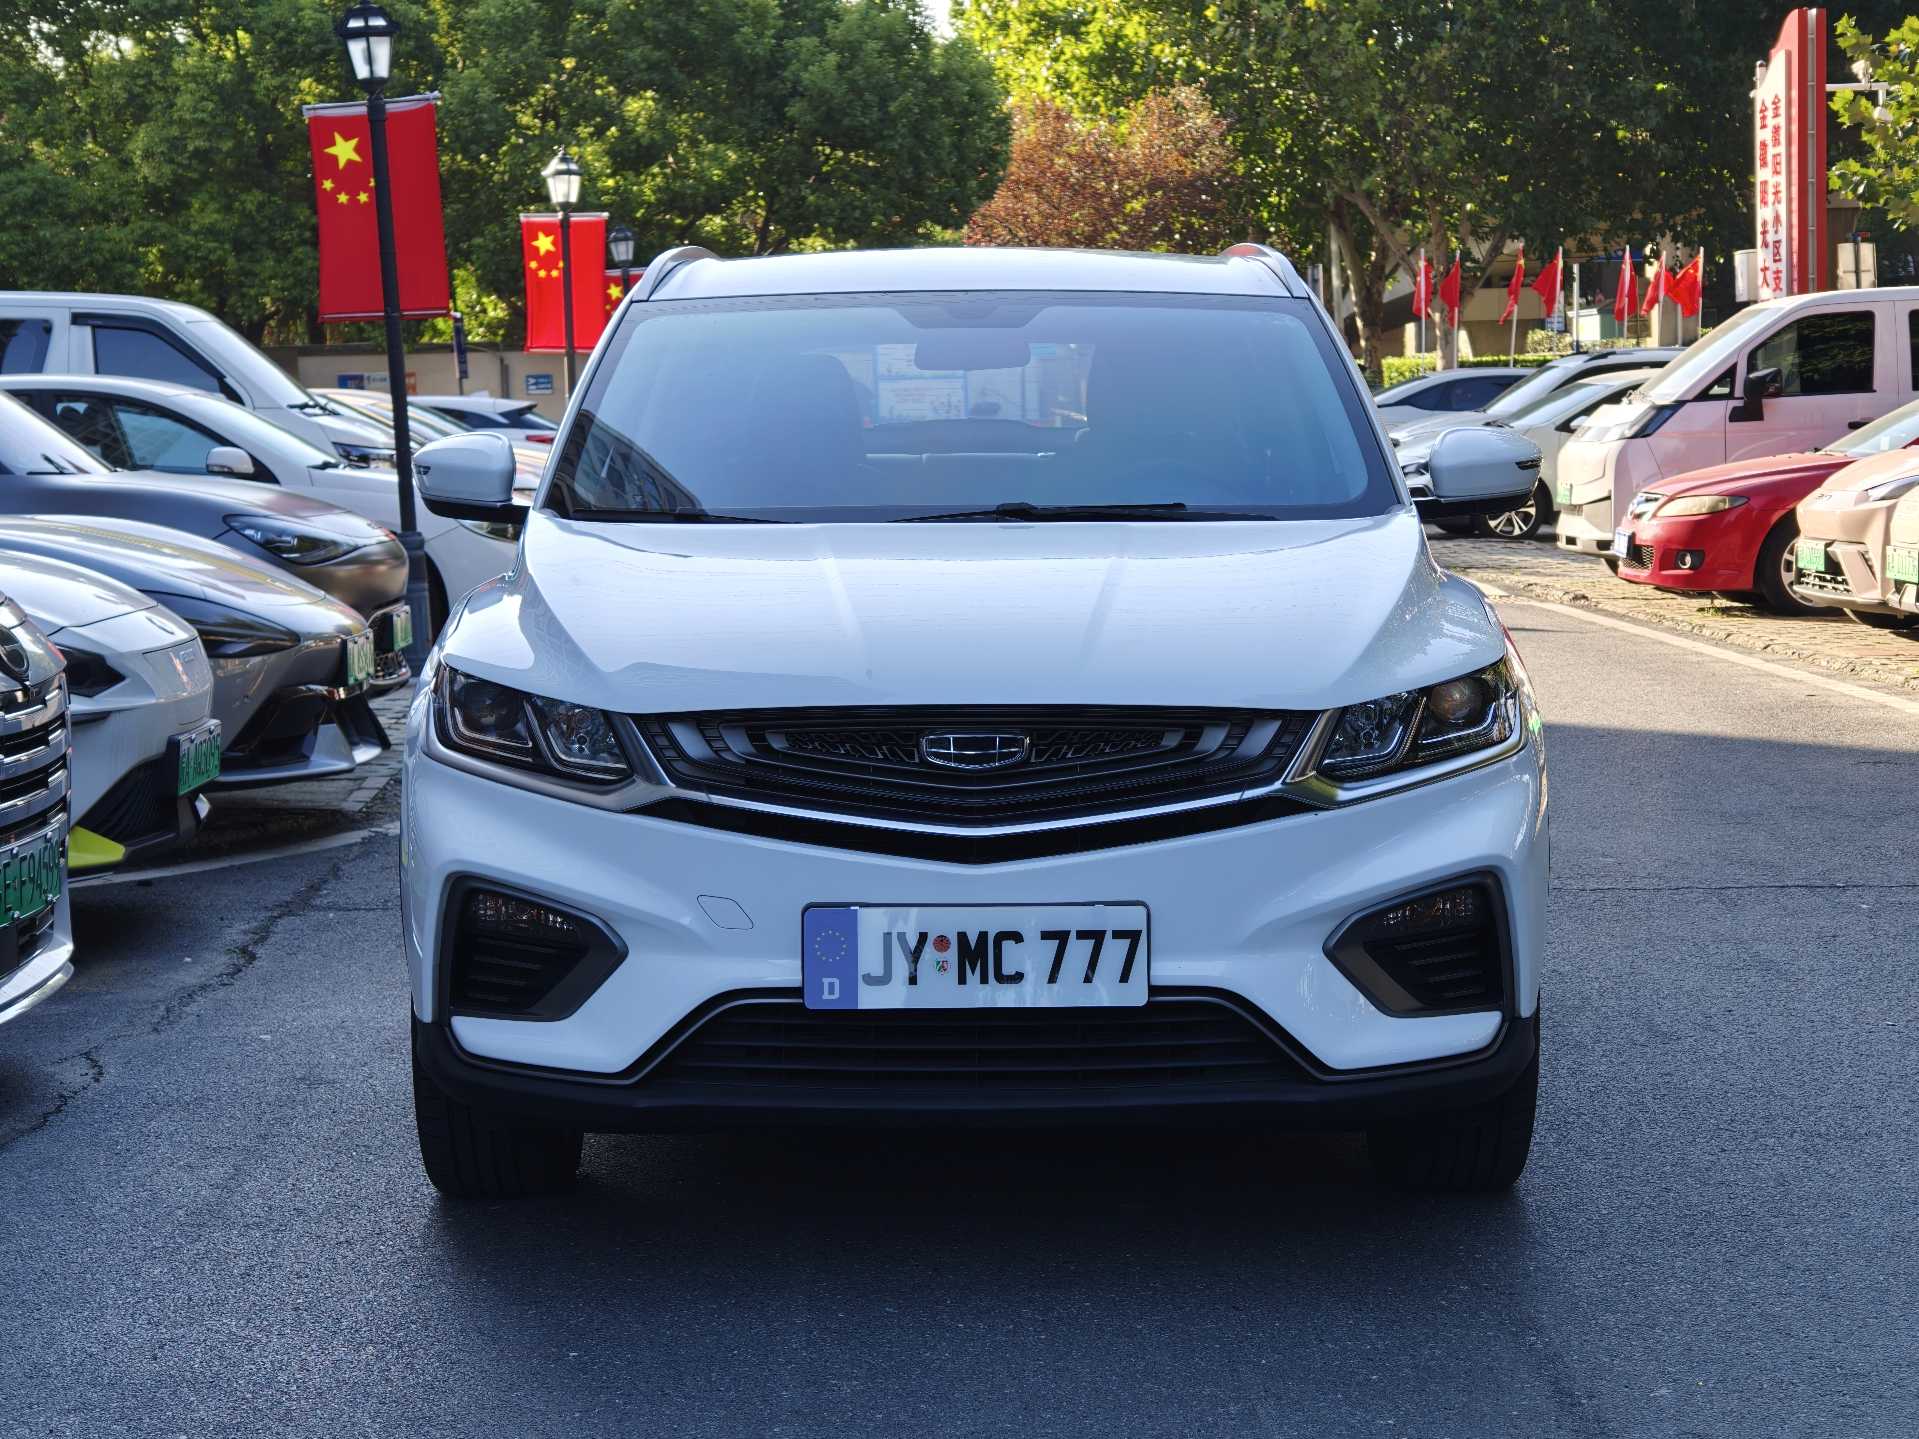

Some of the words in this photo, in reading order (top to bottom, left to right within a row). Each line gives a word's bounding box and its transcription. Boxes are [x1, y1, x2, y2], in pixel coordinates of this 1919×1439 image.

[862, 930, 928, 987] JY
[957, 930, 1025, 986] MC
[1040, 929, 1143, 985] 777
[822, 977, 840, 1000] D
